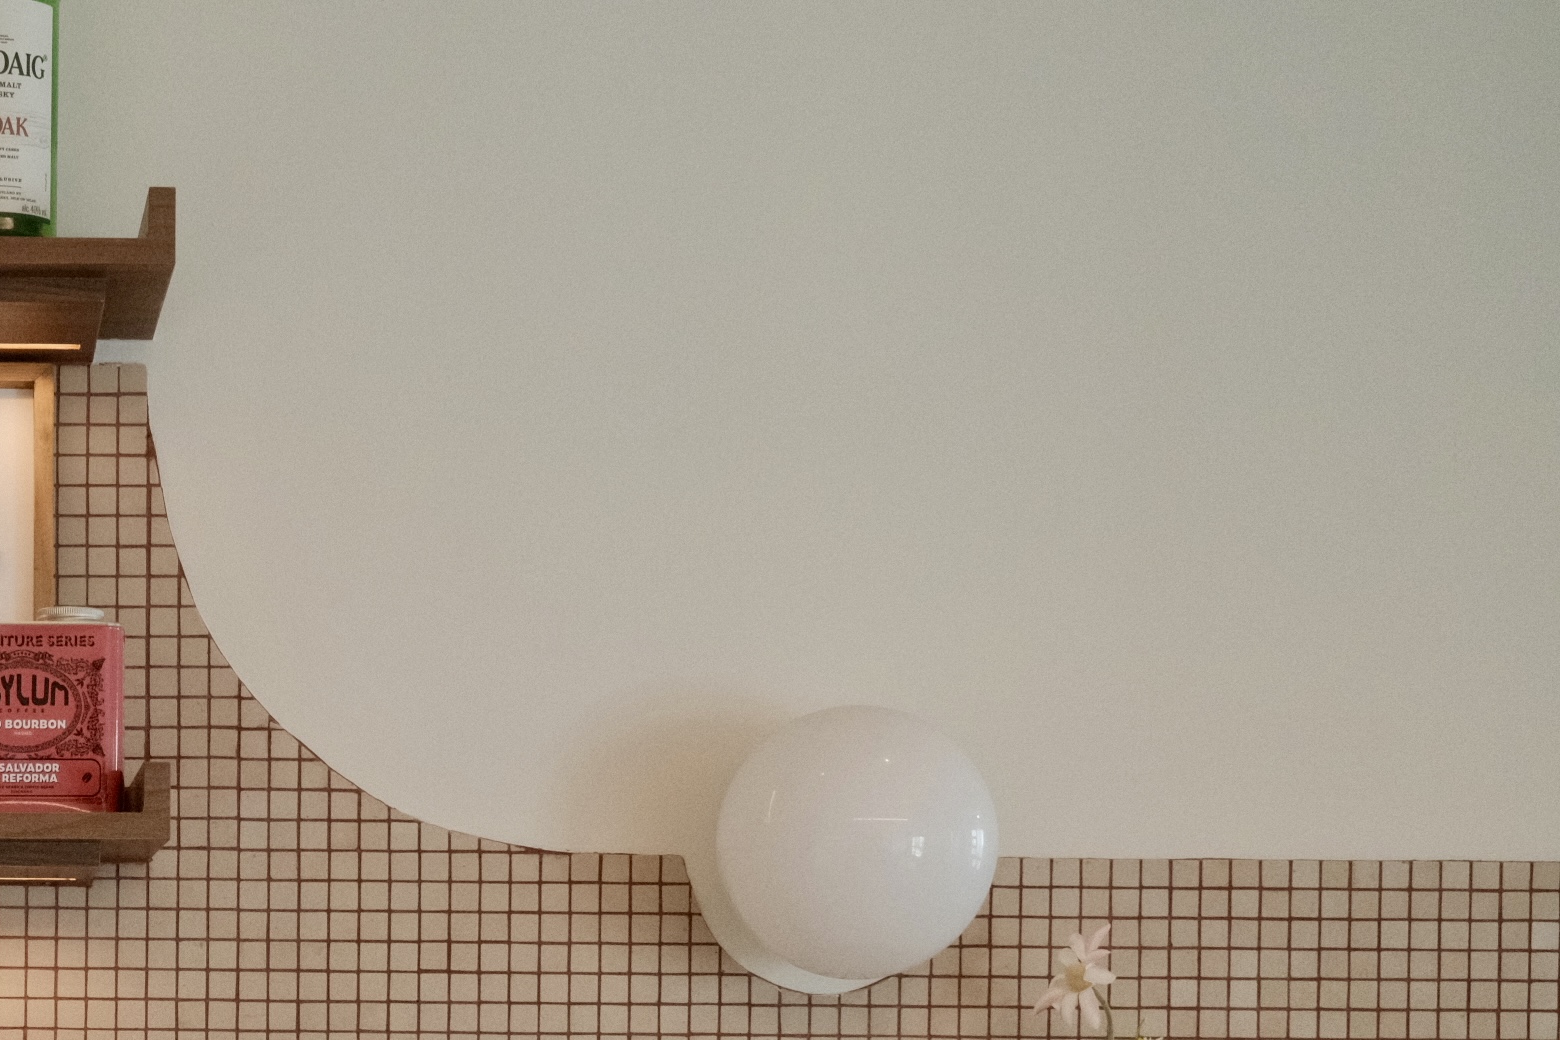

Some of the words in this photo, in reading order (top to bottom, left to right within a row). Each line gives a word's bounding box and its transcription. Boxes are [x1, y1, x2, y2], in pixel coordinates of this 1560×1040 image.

[47, 634, 96, 648] SERIES
[4, 719, 67, 730] BOURBON
[1, 773, 59, 783] REFORMA
